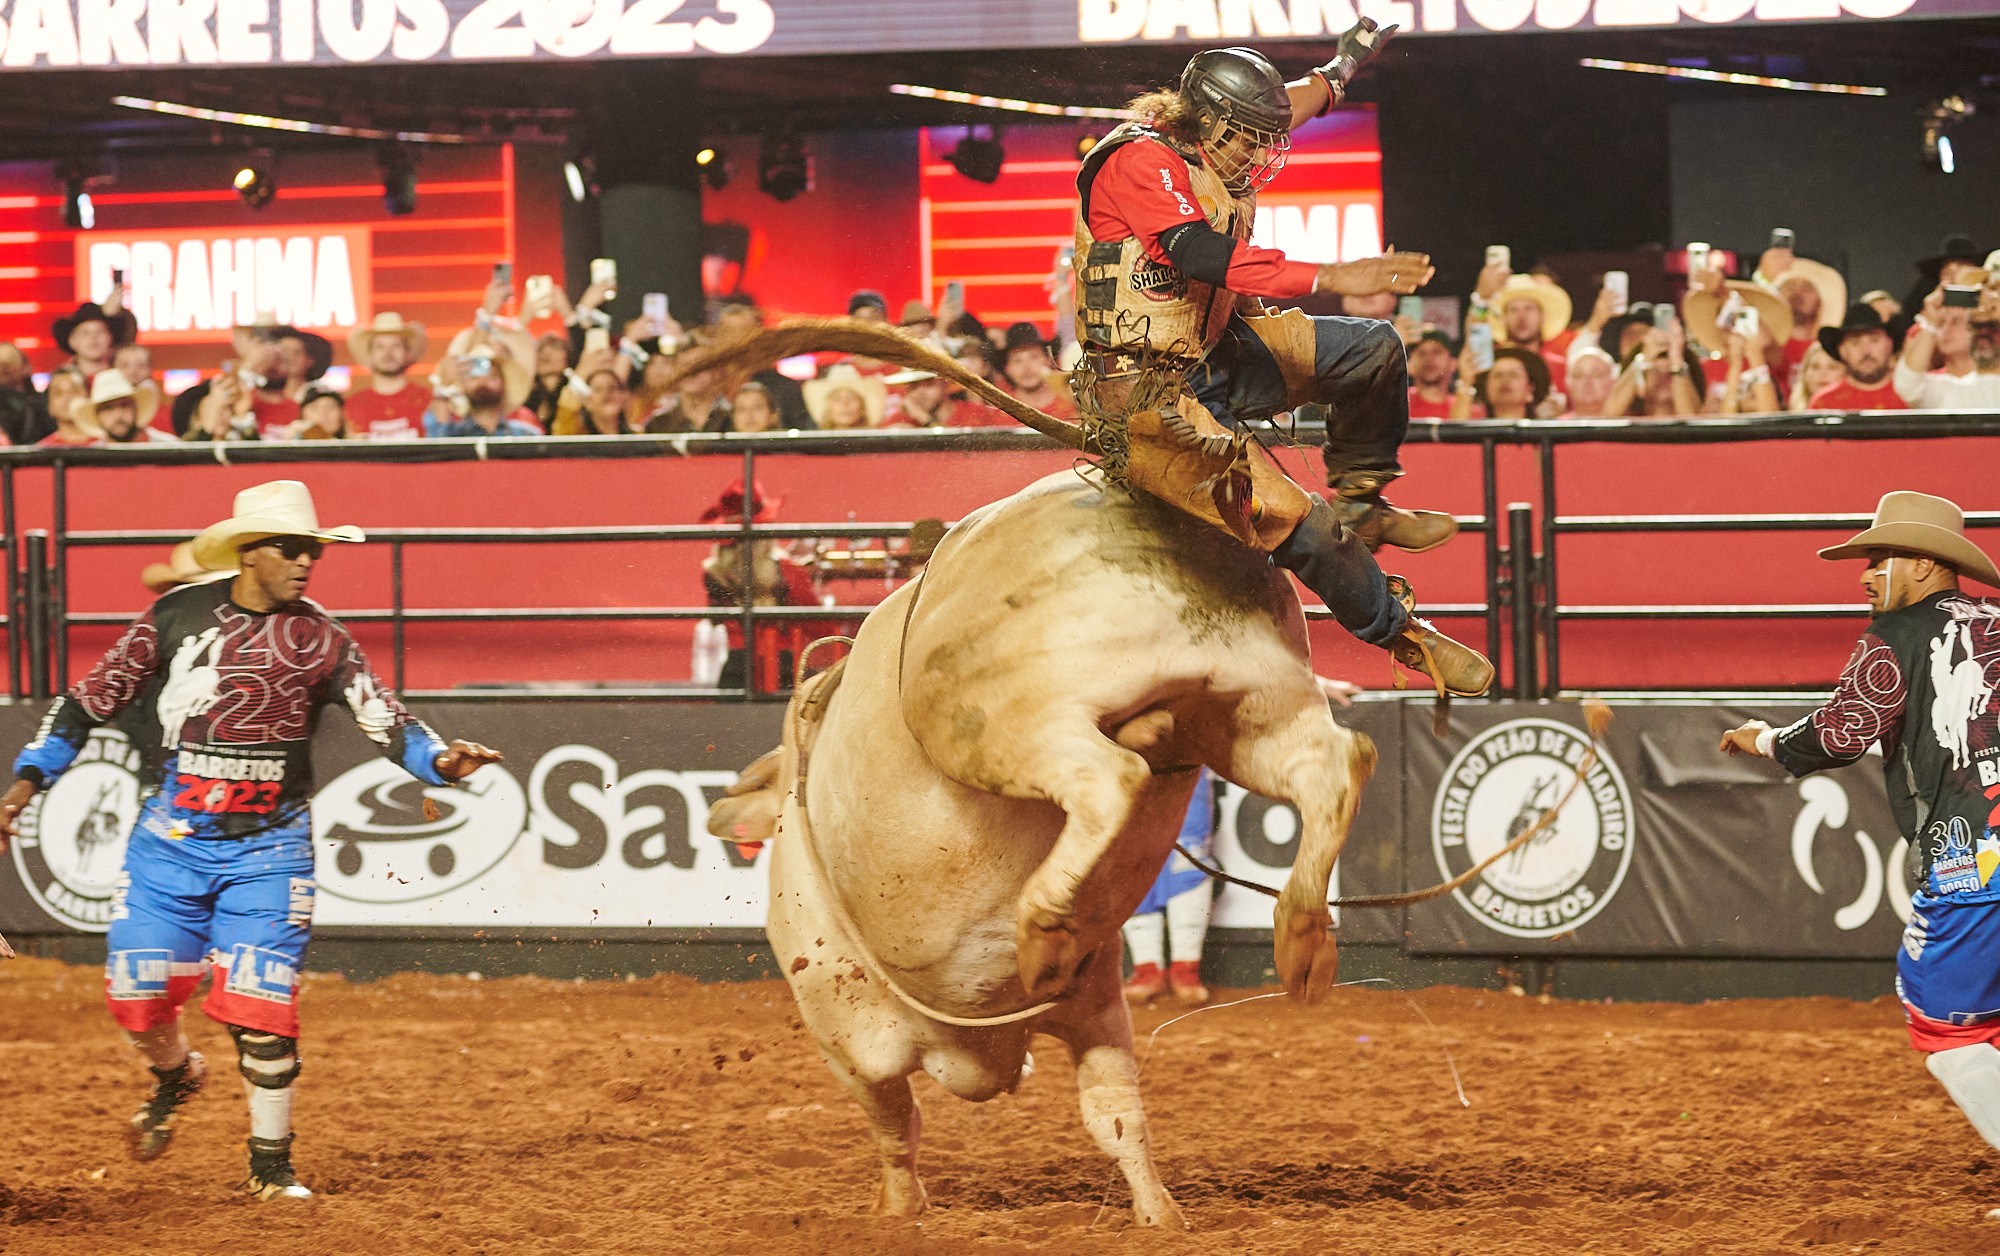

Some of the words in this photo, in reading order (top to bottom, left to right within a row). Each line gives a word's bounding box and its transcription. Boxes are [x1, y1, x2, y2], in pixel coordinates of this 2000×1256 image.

[0, 0, 449, 65] ARRETOS
[177, 750, 287, 782] BARRETOS
[1456, 753, 1489, 788] DO
[1539, 729, 1568, 757] DE
[1974, 745, 2000, 758] FESTA
[173, 774, 283, 815] 2023
[1928, 815, 1972, 857] 30
[1470, 883, 1596, 928] BARRETOS
